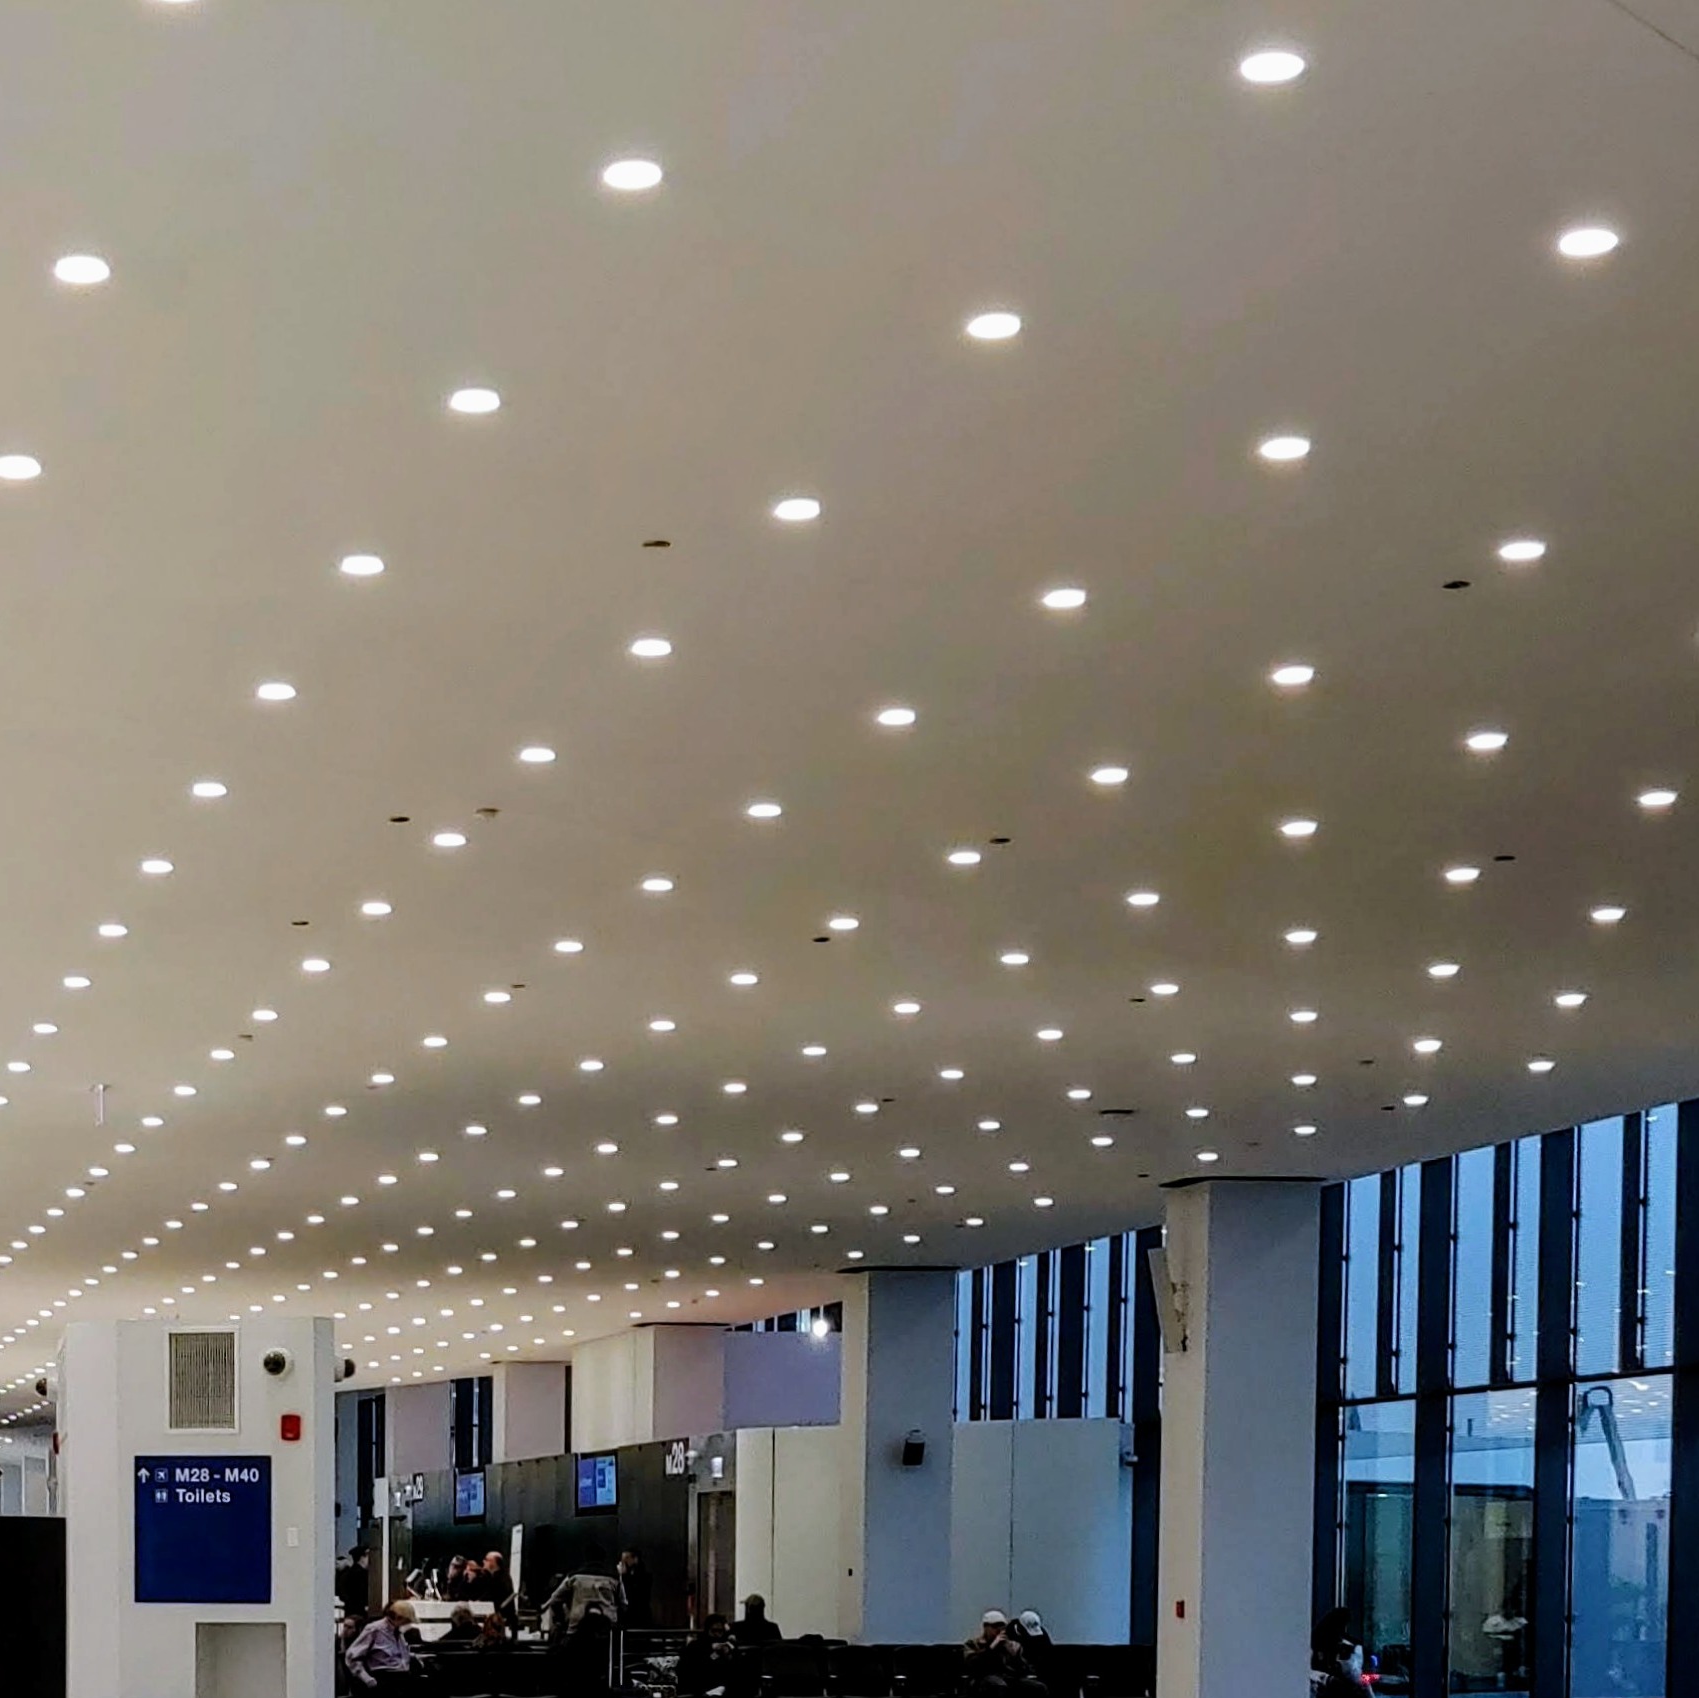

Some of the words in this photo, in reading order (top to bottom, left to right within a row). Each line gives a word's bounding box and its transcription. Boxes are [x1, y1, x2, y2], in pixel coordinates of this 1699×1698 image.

[665, 1441, 685, 1475] M28
[174, 1467, 210, 1483] M28
[224, 1467, 260, 1483] M40
[175, 1488, 231, 1503] Toilets
